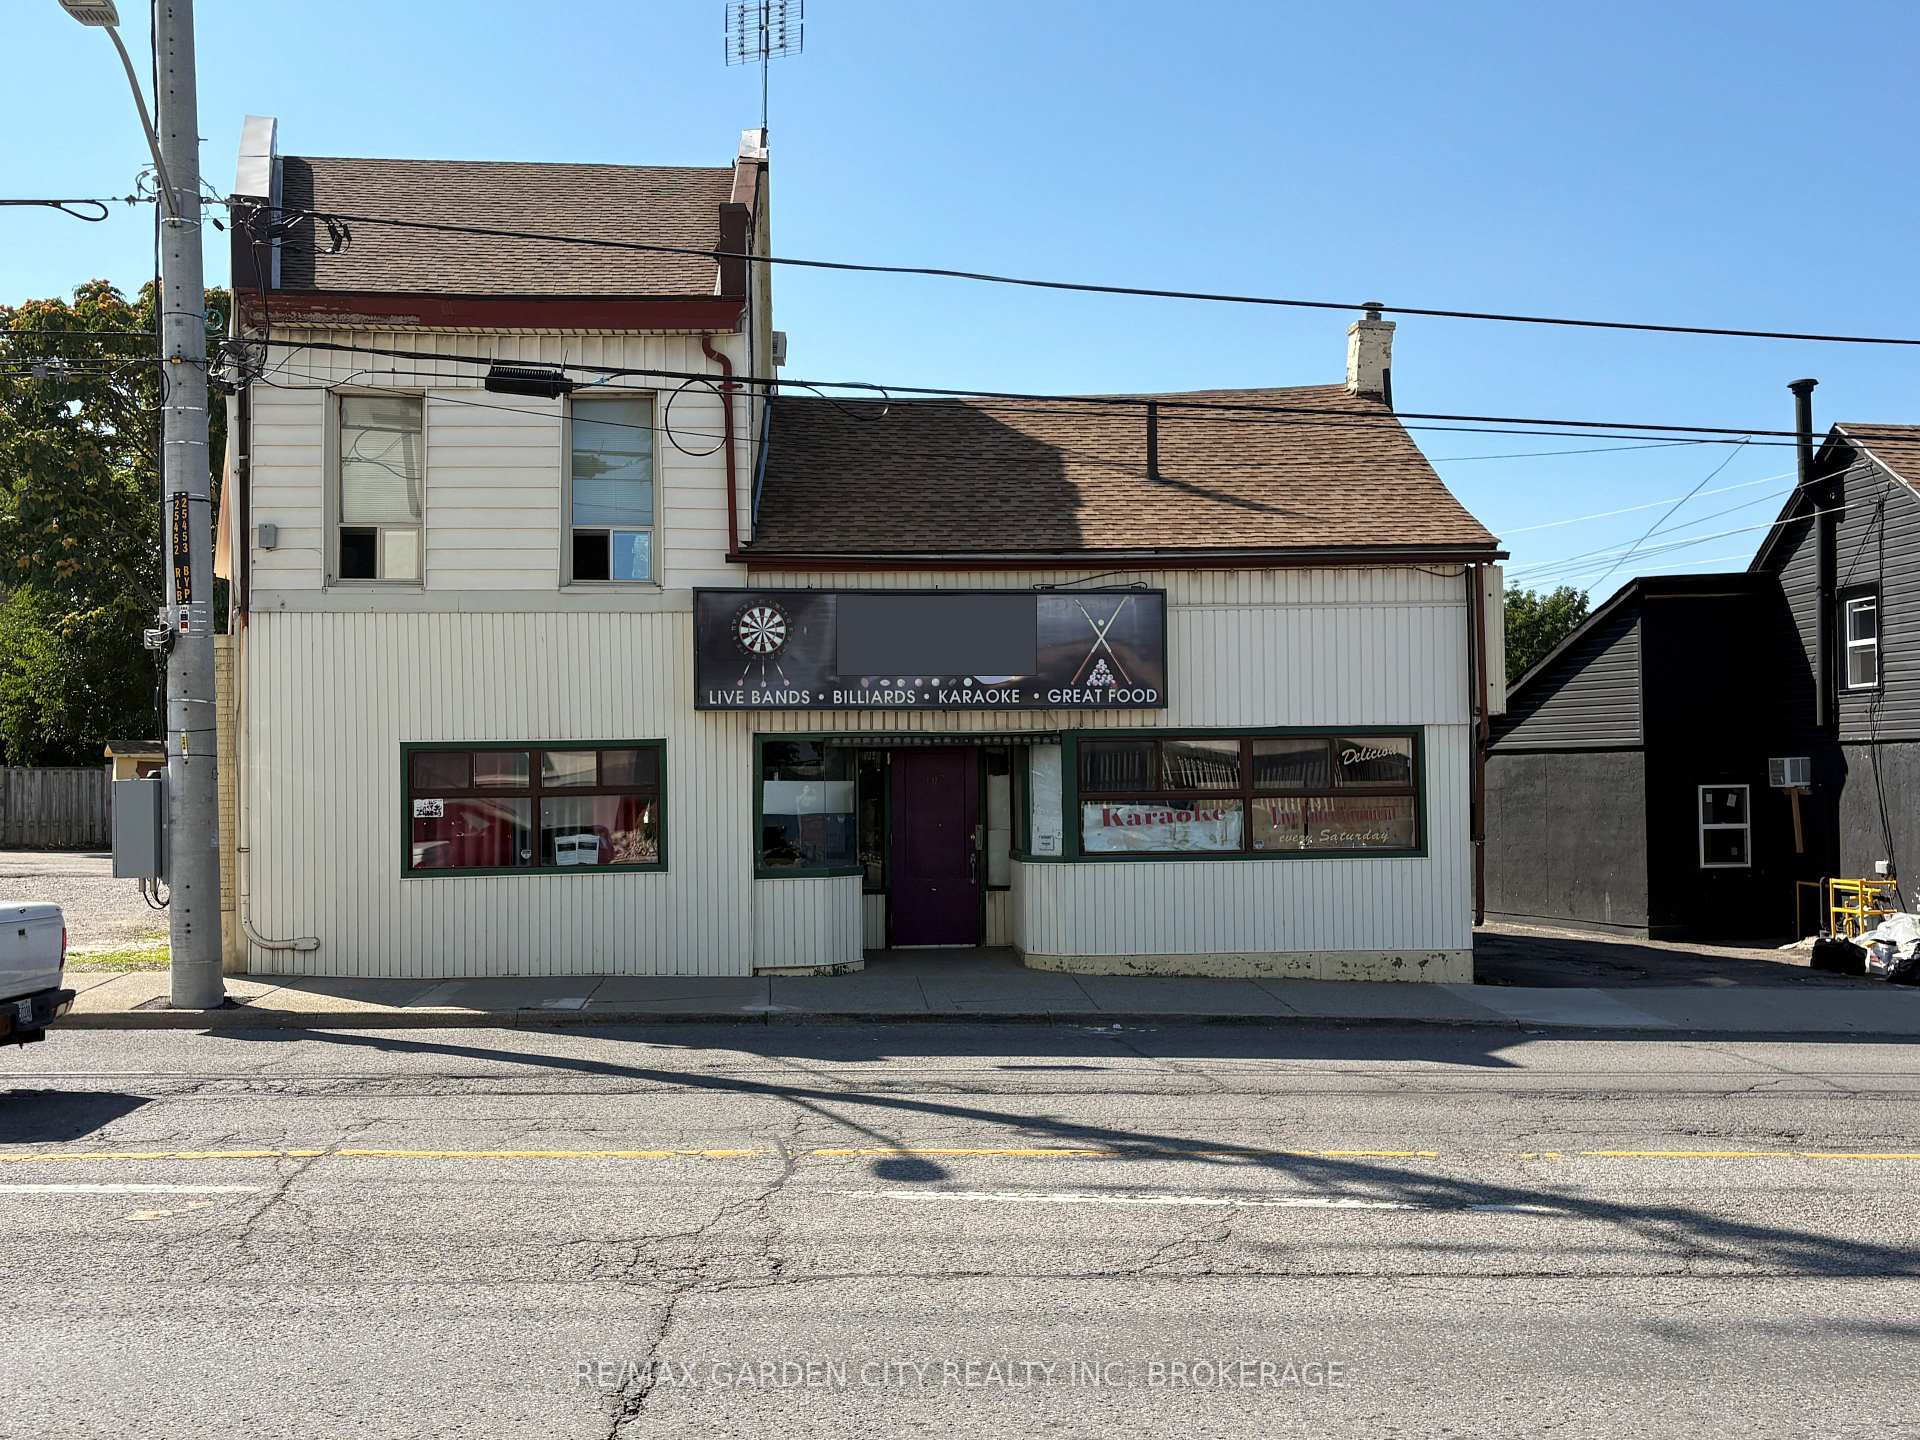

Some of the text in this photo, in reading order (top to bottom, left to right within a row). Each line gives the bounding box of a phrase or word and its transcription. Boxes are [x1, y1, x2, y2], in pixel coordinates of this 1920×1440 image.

[709, 688, 1157, 705] LIVE BANDS BILLIARDS KARAOKE GREAT FOOD
[1103, 804, 1226, 827] Karaoke
[1320, 828, 1390, 843] Saturday
